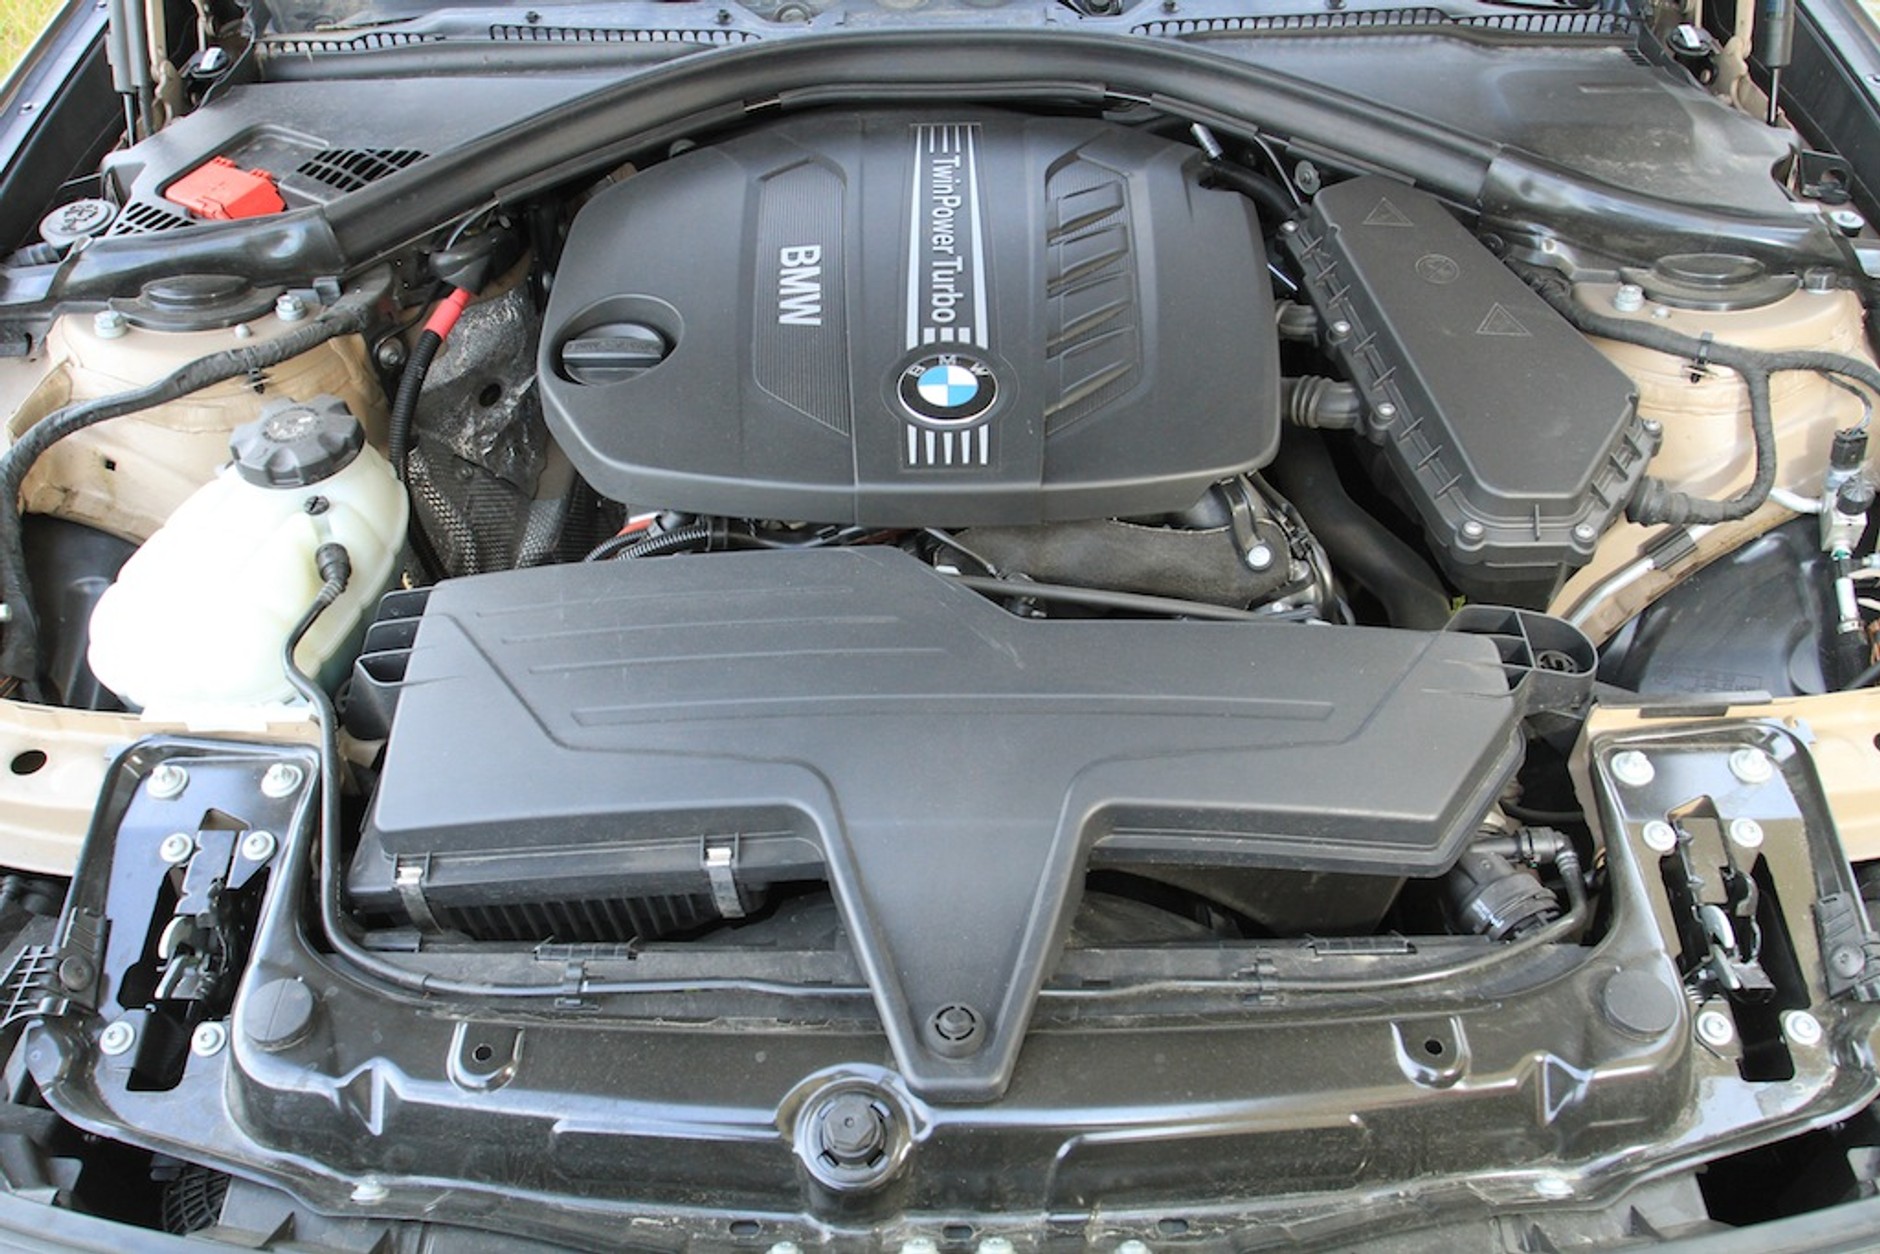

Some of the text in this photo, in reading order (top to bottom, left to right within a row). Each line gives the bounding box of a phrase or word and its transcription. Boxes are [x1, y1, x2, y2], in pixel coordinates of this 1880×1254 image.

[931, 155, 964, 323] TwinPower Turbo
[779, 244, 822, 326] BMW
[906, 354, 990, 378] BMW
